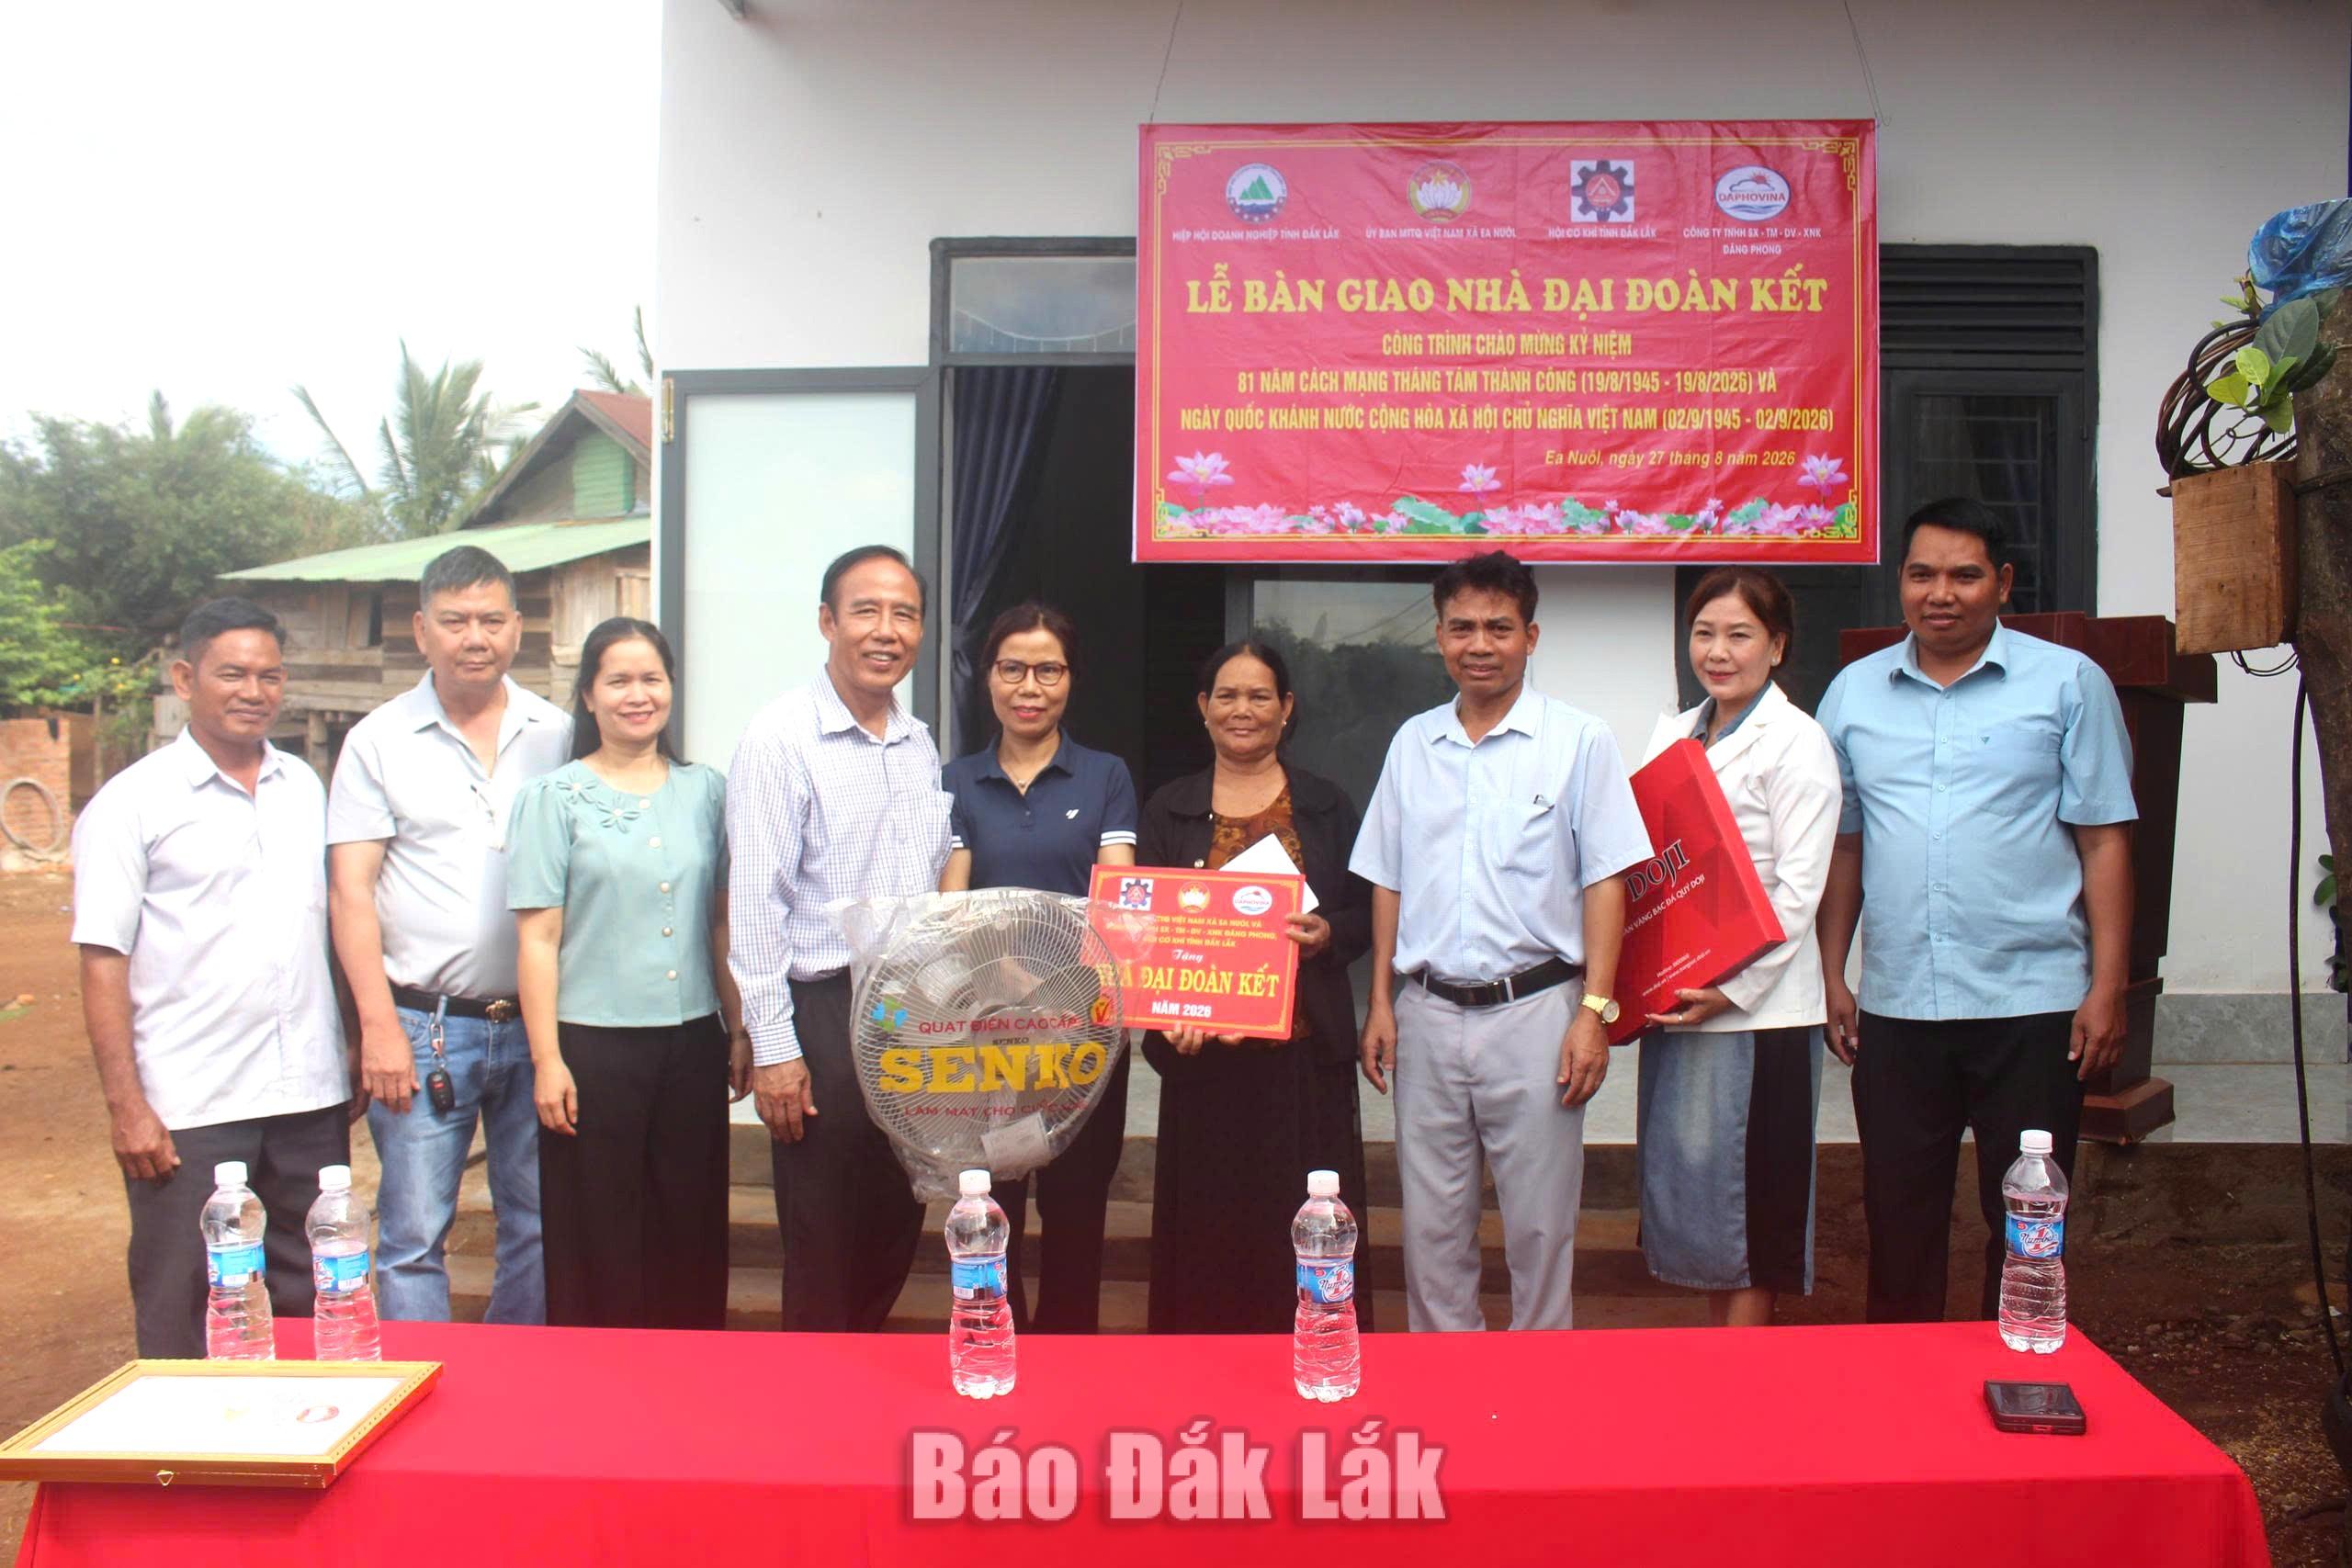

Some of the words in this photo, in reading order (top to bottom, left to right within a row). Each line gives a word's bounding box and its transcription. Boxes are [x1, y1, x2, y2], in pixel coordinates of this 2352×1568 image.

[1718, 191, 1786, 203] DAPHOVINA
[1212, 230, 1244, 241] DOANH
[1379, 228, 1396, 239] BAN
[1443, 228, 1464, 239] NAM
[1480, 228, 1491, 239] EA
[1683, 225, 1710, 239] CÔNG
[1712, 228, 1722, 239] TY
[1724, 228, 1746, 239] TNHH
[1748, 228, 1759, 239] SX
[1766, 228, 1778, 239] TM
[1804, 228, 1822, 239] XNK
[1750, 244, 1782, 255] PHONG
[1186, 263, 1232, 313] LỄ
[1243, 269, 1326, 313] BÀN
[1336, 278, 1435, 312] GIAO
[1446, 268, 1532, 312] NHÀ
[1543, 278, 1614, 321] ĐẠI
[1625, 268, 1738, 312] ĐOÀN
[1750, 263, 1828, 312] KẾT
[1382, 329, 1423, 355] CÔNG
[1427, 329, 1472, 355] TRÌNH
[1476, 329, 1516, 355] CHÀO
[1520, 328, 1566, 355] MỪNG
[1569, 326, 1589, 355] KỶ
[1592, 330, 1633, 361] NIỆM
[1238, 371, 1255, 393] 81
[1261, 368, 1295, 393] NĂM
[1300, 367, 1340, 393] CÁCH
[1343, 370, 1388, 397] MẠNG
[1392, 366, 1442, 393] THÁNG
[1446, 366, 1478, 393] TÁM
[1482, 367, 1531, 393] THÀNH
[1535, 367, 1577, 393] CÔNG
[1580, 370, 1660, 394] (19/8/1945
[1675, 370, 1753, 394] 19/8/2026)
[1757, 367, 1777, 393] VÀ
[1181, 403, 1221, 430] NGÀY
[1225, 400, 1264, 432] QUỐC
[1269, 402, 1319, 430] KHÁNH
[1324, 402, 1364, 430] NƯỚC
[1369, 402, 1409, 434] CỘNG
[1414, 401, 1444, 430] HÒA
[1449, 403, 1468, 430] XÃ
[1473, 402, 1498, 434] HỘI
[1502, 400, 1532, 430] CHỦ
[1536, 403, 1584, 430] NGHĨA
[1587, 402, 1619, 434] VIỆT
[1623, 407, 1657, 430] NAM
[1662, 407, 1742, 432] (02/9/1945
[1756, 407, 1835, 432] 02/9/2026)
[1544, 450, 1564, 466] Ea
[1567, 449, 1604, 468] Nuôl,
[1609, 449, 1645, 468] ngày
[1648, 451, 1665, 466] 27
[1668, 449, 1710, 468] tháng
[1714, 451, 1724, 466] 8
[1727, 449, 1758, 466] năm
[1761, 451, 1796, 466] 2026
[1624, 839, 1690, 903] DOJI
[1634, 909, 1653, 929] VÀNG
[1142, 965, 1175, 996] ĐẠI
[1178, 964, 1234, 995] ĐOÀN
[1237, 962, 1280, 998] KẾT
[1151, 998, 1180, 1016] NĂM
[1182, 1004, 1213, 1019] 2026
[878, 1042, 1108, 1094] SENKO
